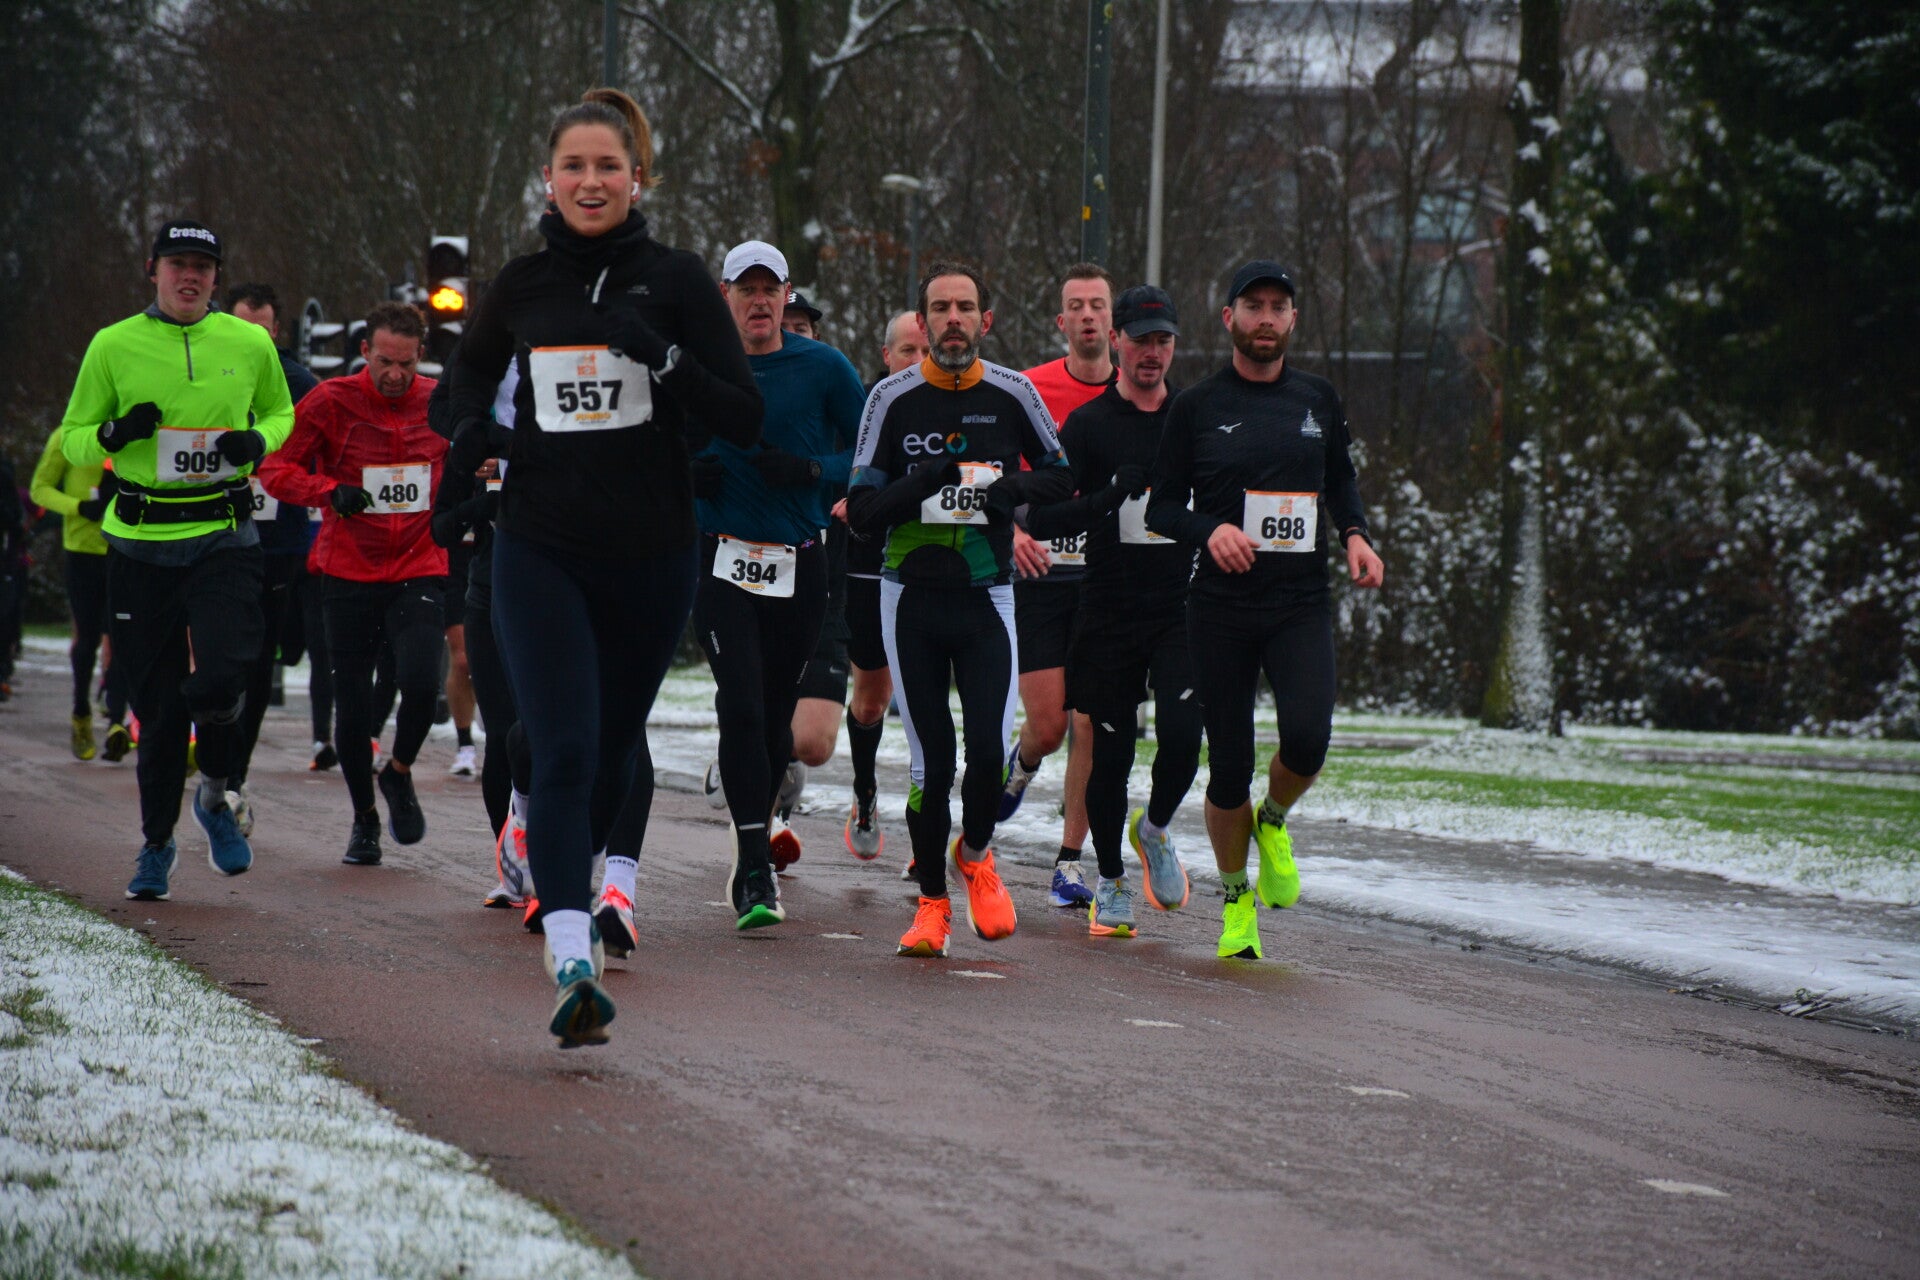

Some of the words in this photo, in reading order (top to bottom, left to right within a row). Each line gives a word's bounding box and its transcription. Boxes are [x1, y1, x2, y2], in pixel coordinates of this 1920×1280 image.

[169, 227, 216, 245] CrossFit
[556, 380, 623, 413] 557
[856, 370, 915, 457] www.ecogroen.nl
[903, 432, 968, 455] eco
[174, 450, 221, 473] 909
[378, 483, 418, 503] 480
[940, 486, 988, 511] 865
[1261, 516, 1306, 540] 698
[1050, 534, 1087, 554] 982
[731, 558, 777, 584] 394
